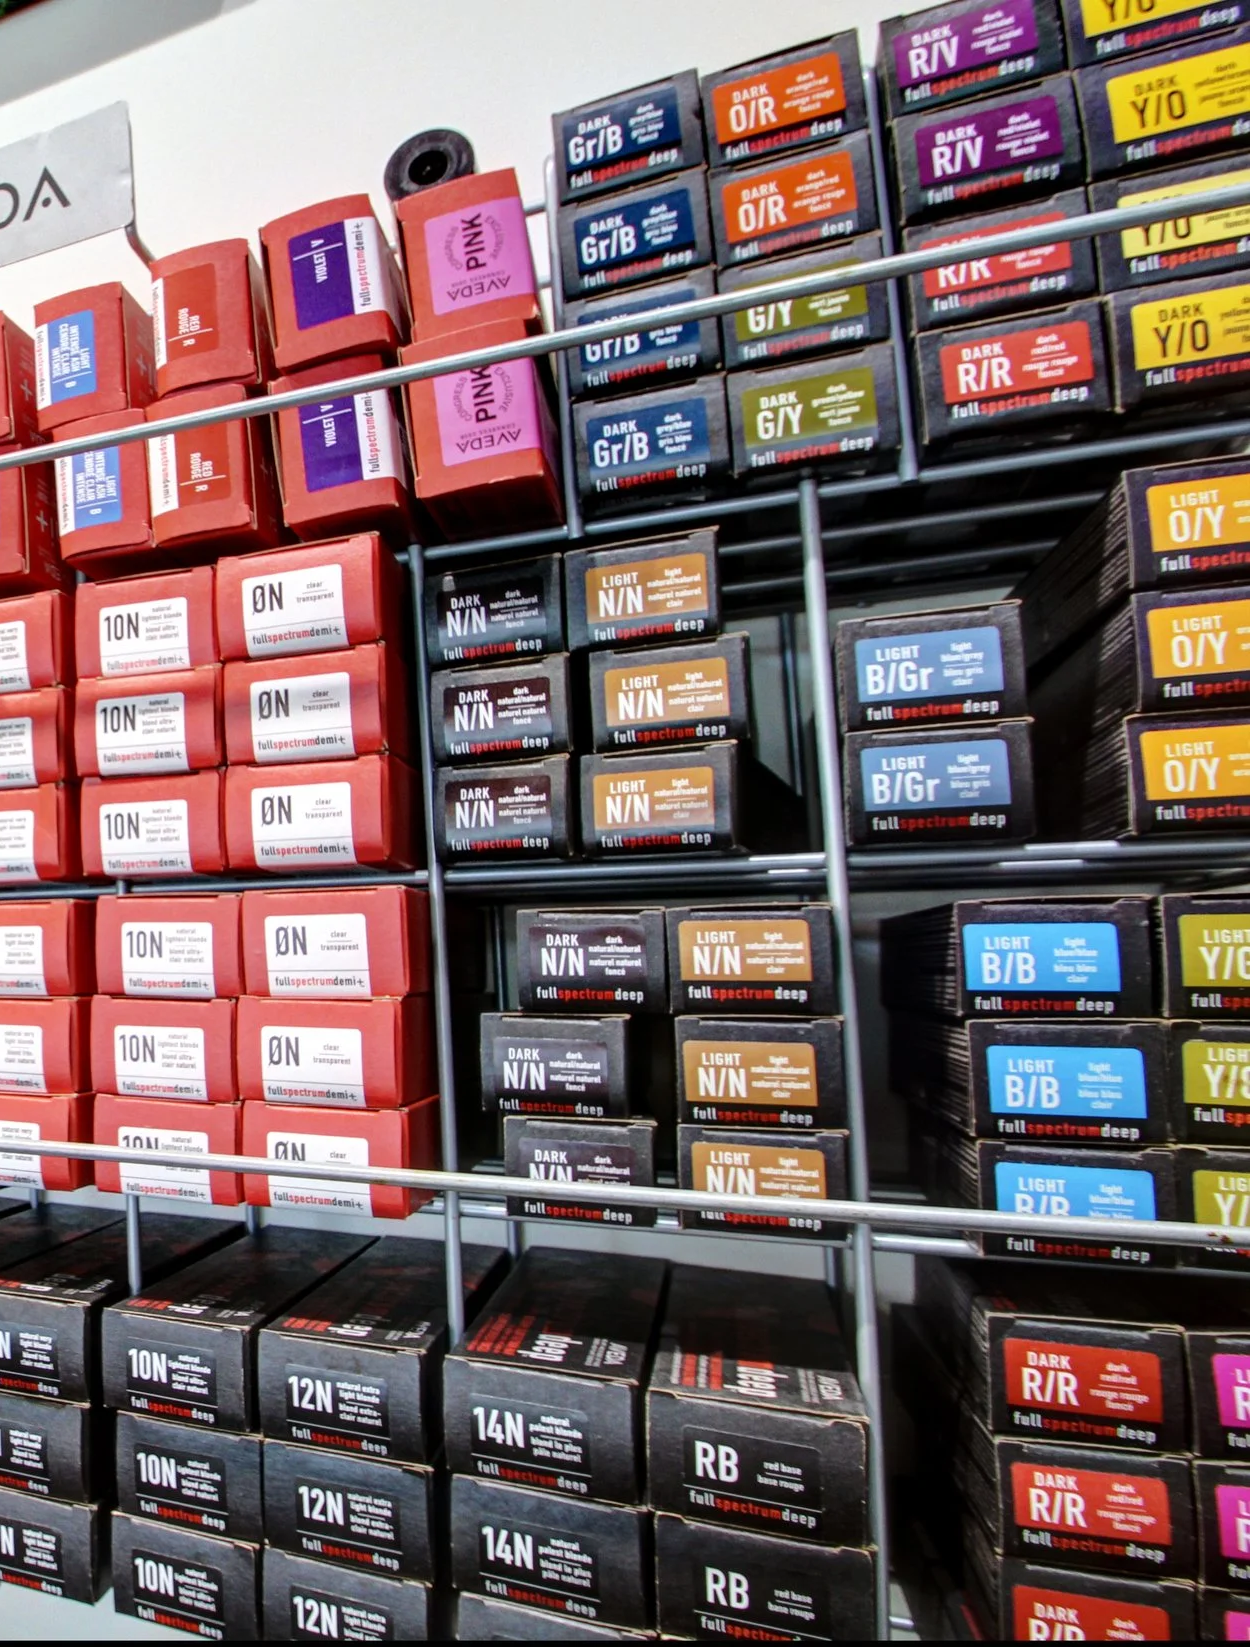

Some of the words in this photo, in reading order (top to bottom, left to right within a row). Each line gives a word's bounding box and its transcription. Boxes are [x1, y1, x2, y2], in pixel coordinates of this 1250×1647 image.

[911, 24, 952, 48] DARK
[908, 39, 959, 80] R/V
[732, 83, 769, 103] DARK
[729, 98, 777, 134] O/R
[1130, 90, 1186, 129] Y/O
[577, 114, 611, 135] DARK
[935, 123, 976, 145] DARK
[568, 125, 623, 166] Gr/B
[931, 135, 984, 179] R/V
[569, 148, 678, 190] fullspectrumdeep
[741, 181, 778, 202] DARK
[589, 214, 624, 235] DARK
[737, 195, 787, 234] O/R
[460, 212, 488, 273] PINK
[580, 224, 637, 266] Gr/B
[315, 251, 328, 283] VIOLET
[447, 275, 511, 302] AVEDA
[1158, 302, 1204, 323] DARK
[961, 342, 1003, 361] DARK
[1153, 319, 1210, 359] Y/O
[957, 356, 1013, 395] R/R
[759, 391, 798, 407] DARK
[951, 385, 1089, 420] fullspectrumdeep
[325, 418, 336, 447] VIOLET
[603, 419, 637, 438] DARK
[756, 404, 803, 440] G/Y
[456, 428, 522, 454] AVEDA
[593, 431, 650, 469] Gr/B
[750, 434, 874, 468] fullspectrumdeep
[595, 463, 706, 493] fullspectrumdeep
[1169, 489, 1219, 509] LIGHT
[1168, 505, 1225, 543] O/Y
[602, 572, 638, 588] LIGHT
[450, 594, 480, 610] DARK
[598, 585, 643, 618] N/N
[104, 611, 140, 642] 10N
[446, 607, 487, 637] N/N
[594, 618, 705, 641] fullspectrumdeep
[1172, 615, 1222, 633] LIGHT
[875, 645, 920, 662] LIGHT
[1171, 632, 1227, 668] O/Y
[621, 675, 659, 691] LIGHT
[865, 660, 933, 696] B/Gr
[302, 701, 340, 711] transparent
[312, 690, 329, 698] clear
[458, 689, 489, 704] DARK
[617, 690, 664, 721] N/N
[100, 704, 136, 733] 10N
[454, 702, 494, 732] N/N
[866, 700, 999, 722] fullspectrumdeep
[614, 723, 726, 744] fullspectrumdeep
[881, 756, 926, 771] LIGHT
[460, 787, 490, 800] DARK
[609, 780, 646, 794] LIGHT
[871, 771, 940, 805] B/Gr
[455, 799, 494, 829] N/N
[605, 794, 650, 825] N/N
[451, 836, 549, 852] fullspectrumdeep
[126, 930, 163, 958] 10N
[546, 933, 578, 946] DARK
[605, 935, 623, 944] dark
[697, 931, 736, 944] LIGHT
[984, 936, 1031, 951] LIGHT
[541, 947, 584, 977] N/N
[692, 945, 742, 976] N/N
[980, 952, 1036, 985] B/B
[536, 987, 644, 1003] fullspectrumdeep
[688, 985, 808, 1003] fullspectrumdeep
[974, 996, 1114, 1014] fullspectrumdeep
[118, 1034, 155, 1063] 10N
[508, 1048, 540, 1061] DARK
[702, 1052, 741, 1066] LIGHT
[503, 1061, 546, 1090] N/N
[1008, 1059, 1055, 1073] LIGHT
[697, 1066, 748, 1098] N/N
[1004, 1074, 1060, 1109] B/B
[534, 1149, 568, 1164] DARK
[710, 1151, 750, 1166] LIGHT
[524, 1201, 633, 1225] fullspectrumdeep
[128, 1347, 168, 1384] 10N
[1026, 1351, 1071, 1370] DARK
[287, 1375, 333, 1414] 12N
[1020, 1367, 1080, 1407] R/R
[472, 1406, 525, 1449] 14N
[1013, 1410, 1156, 1445] fullspectrumdeep
[136, 1452, 177, 1490] 10N
[693, 1439, 739, 1484] RB
[763, 1460, 777, 1472] red
[779, 1463, 802, 1476] base
[757, 1474, 777, 1487] base
[779, 1478, 805, 1493] rouge
[1033, 1471, 1078, 1491] DARK
[297, 1485, 345, 1526] 12N
[688, 1489, 817, 1529] fullspectrumdeep
[1028, 1487, 1088, 1528] R/R
[480, 1524, 534, 1572] 14N
[704, 1566, 749, 1610] RB
